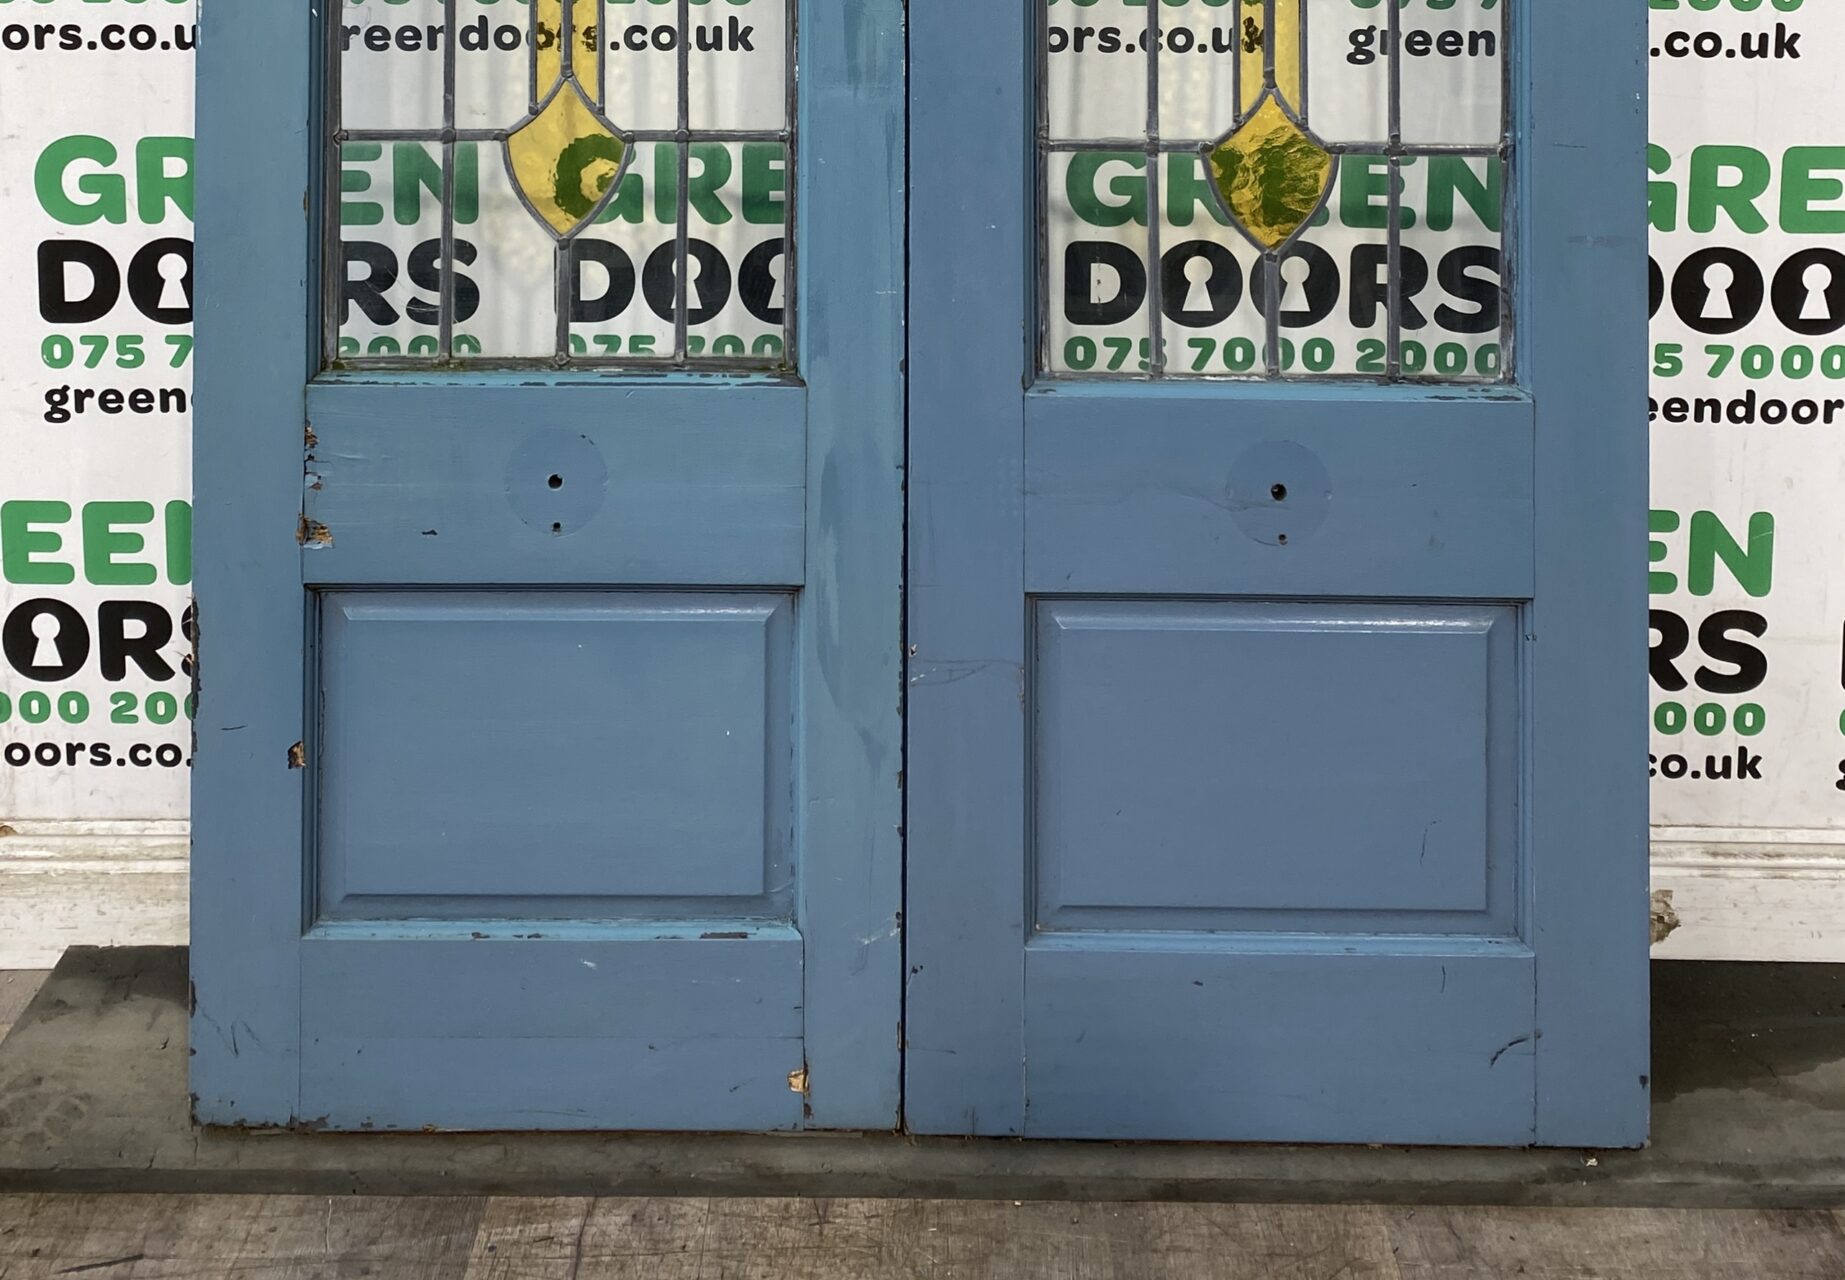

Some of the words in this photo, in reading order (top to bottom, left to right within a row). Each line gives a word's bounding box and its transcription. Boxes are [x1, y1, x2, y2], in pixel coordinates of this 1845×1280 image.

[1650, 22, 1801, 59] .co.uk
[34, 134, 195, 226] GR
[37, 237, 194, 325] DO
[341, 237, 480, 326] RS
[1065, 239, 1502, 334] DOORS
[1648, 246, 1845, 335] OO
[41, 334, 146, 370] 075
[164, 334, 194, 370] 7
[1704, 343, 1845, 380] 7000
[44, 384, 194, 424] green
[2, 597, 192, 682] OR
[109, 690, 194, 725] 20
[1653, 701, 1766, 736] 000
